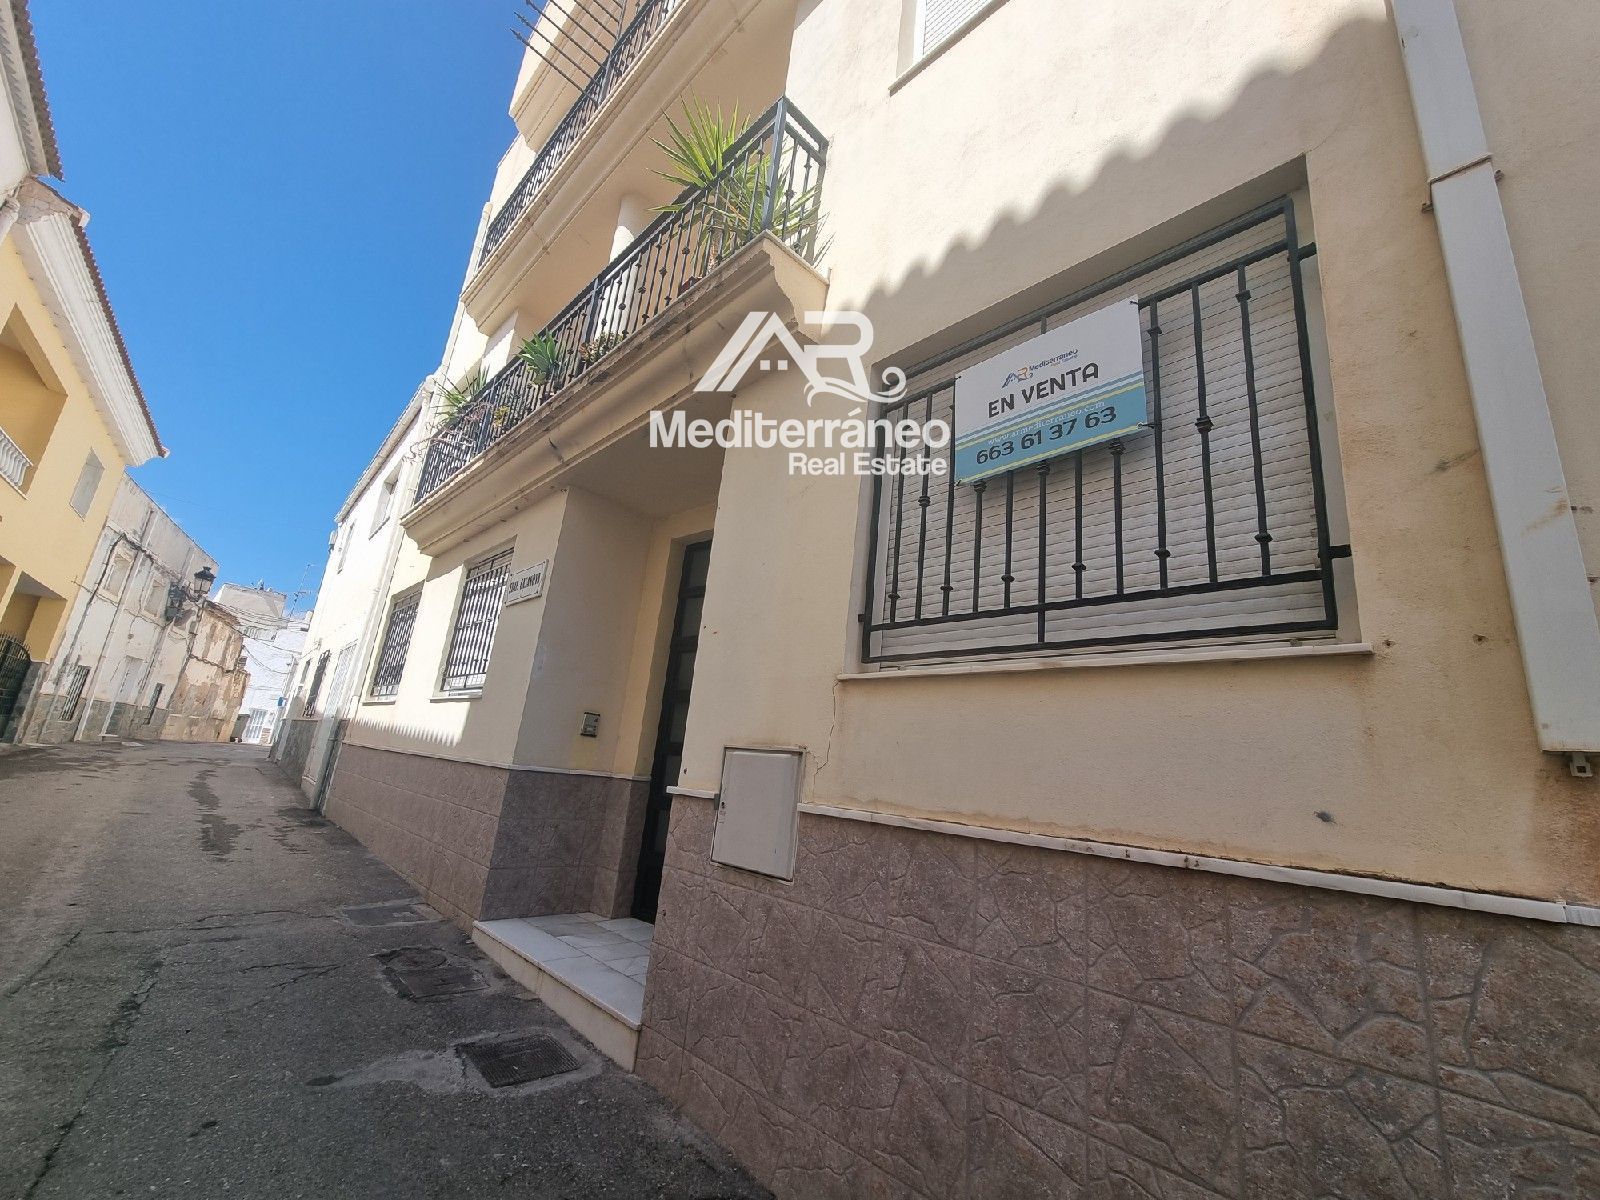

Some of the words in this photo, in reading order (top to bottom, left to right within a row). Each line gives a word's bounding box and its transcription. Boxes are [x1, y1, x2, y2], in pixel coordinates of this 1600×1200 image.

[988, 393, 1015, 418] EN
[1021, 362, 1099, 404] VENTA
[976, 440, 1015, 465] 663
[1021, 429, 1042, 450] 61
[1049, 417, 1078, 441] 37
[1084, 406, 1117, 429] 63
